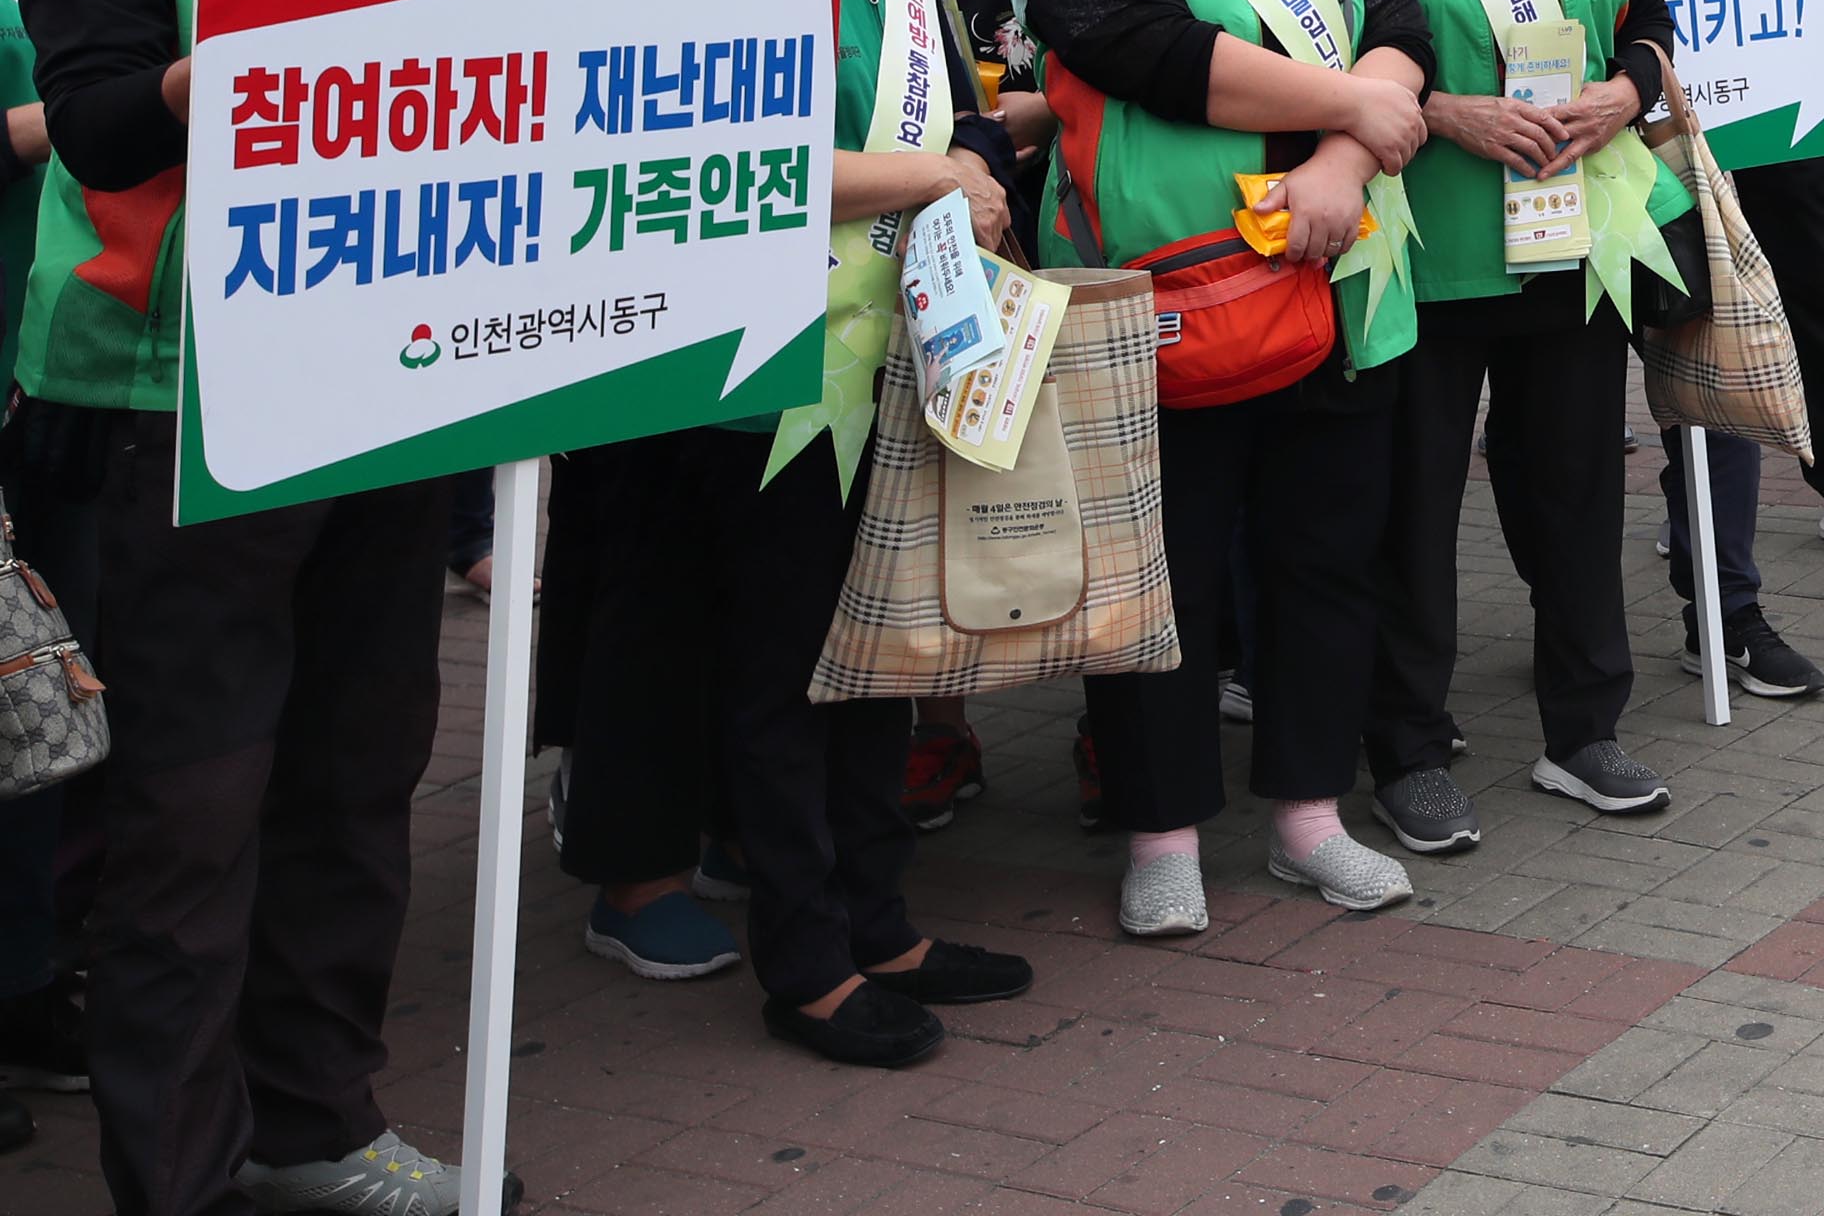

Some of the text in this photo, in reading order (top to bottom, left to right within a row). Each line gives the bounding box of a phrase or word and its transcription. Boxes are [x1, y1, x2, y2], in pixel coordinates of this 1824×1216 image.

[231, 34, 815, 170] 참여하자! 재난대비
[896, 48, 932, 148] 동참해요
[225, 144, 811, 300] 지켜내자! 가족안전
[450, 293, 669, 361] 인천광역시동구
